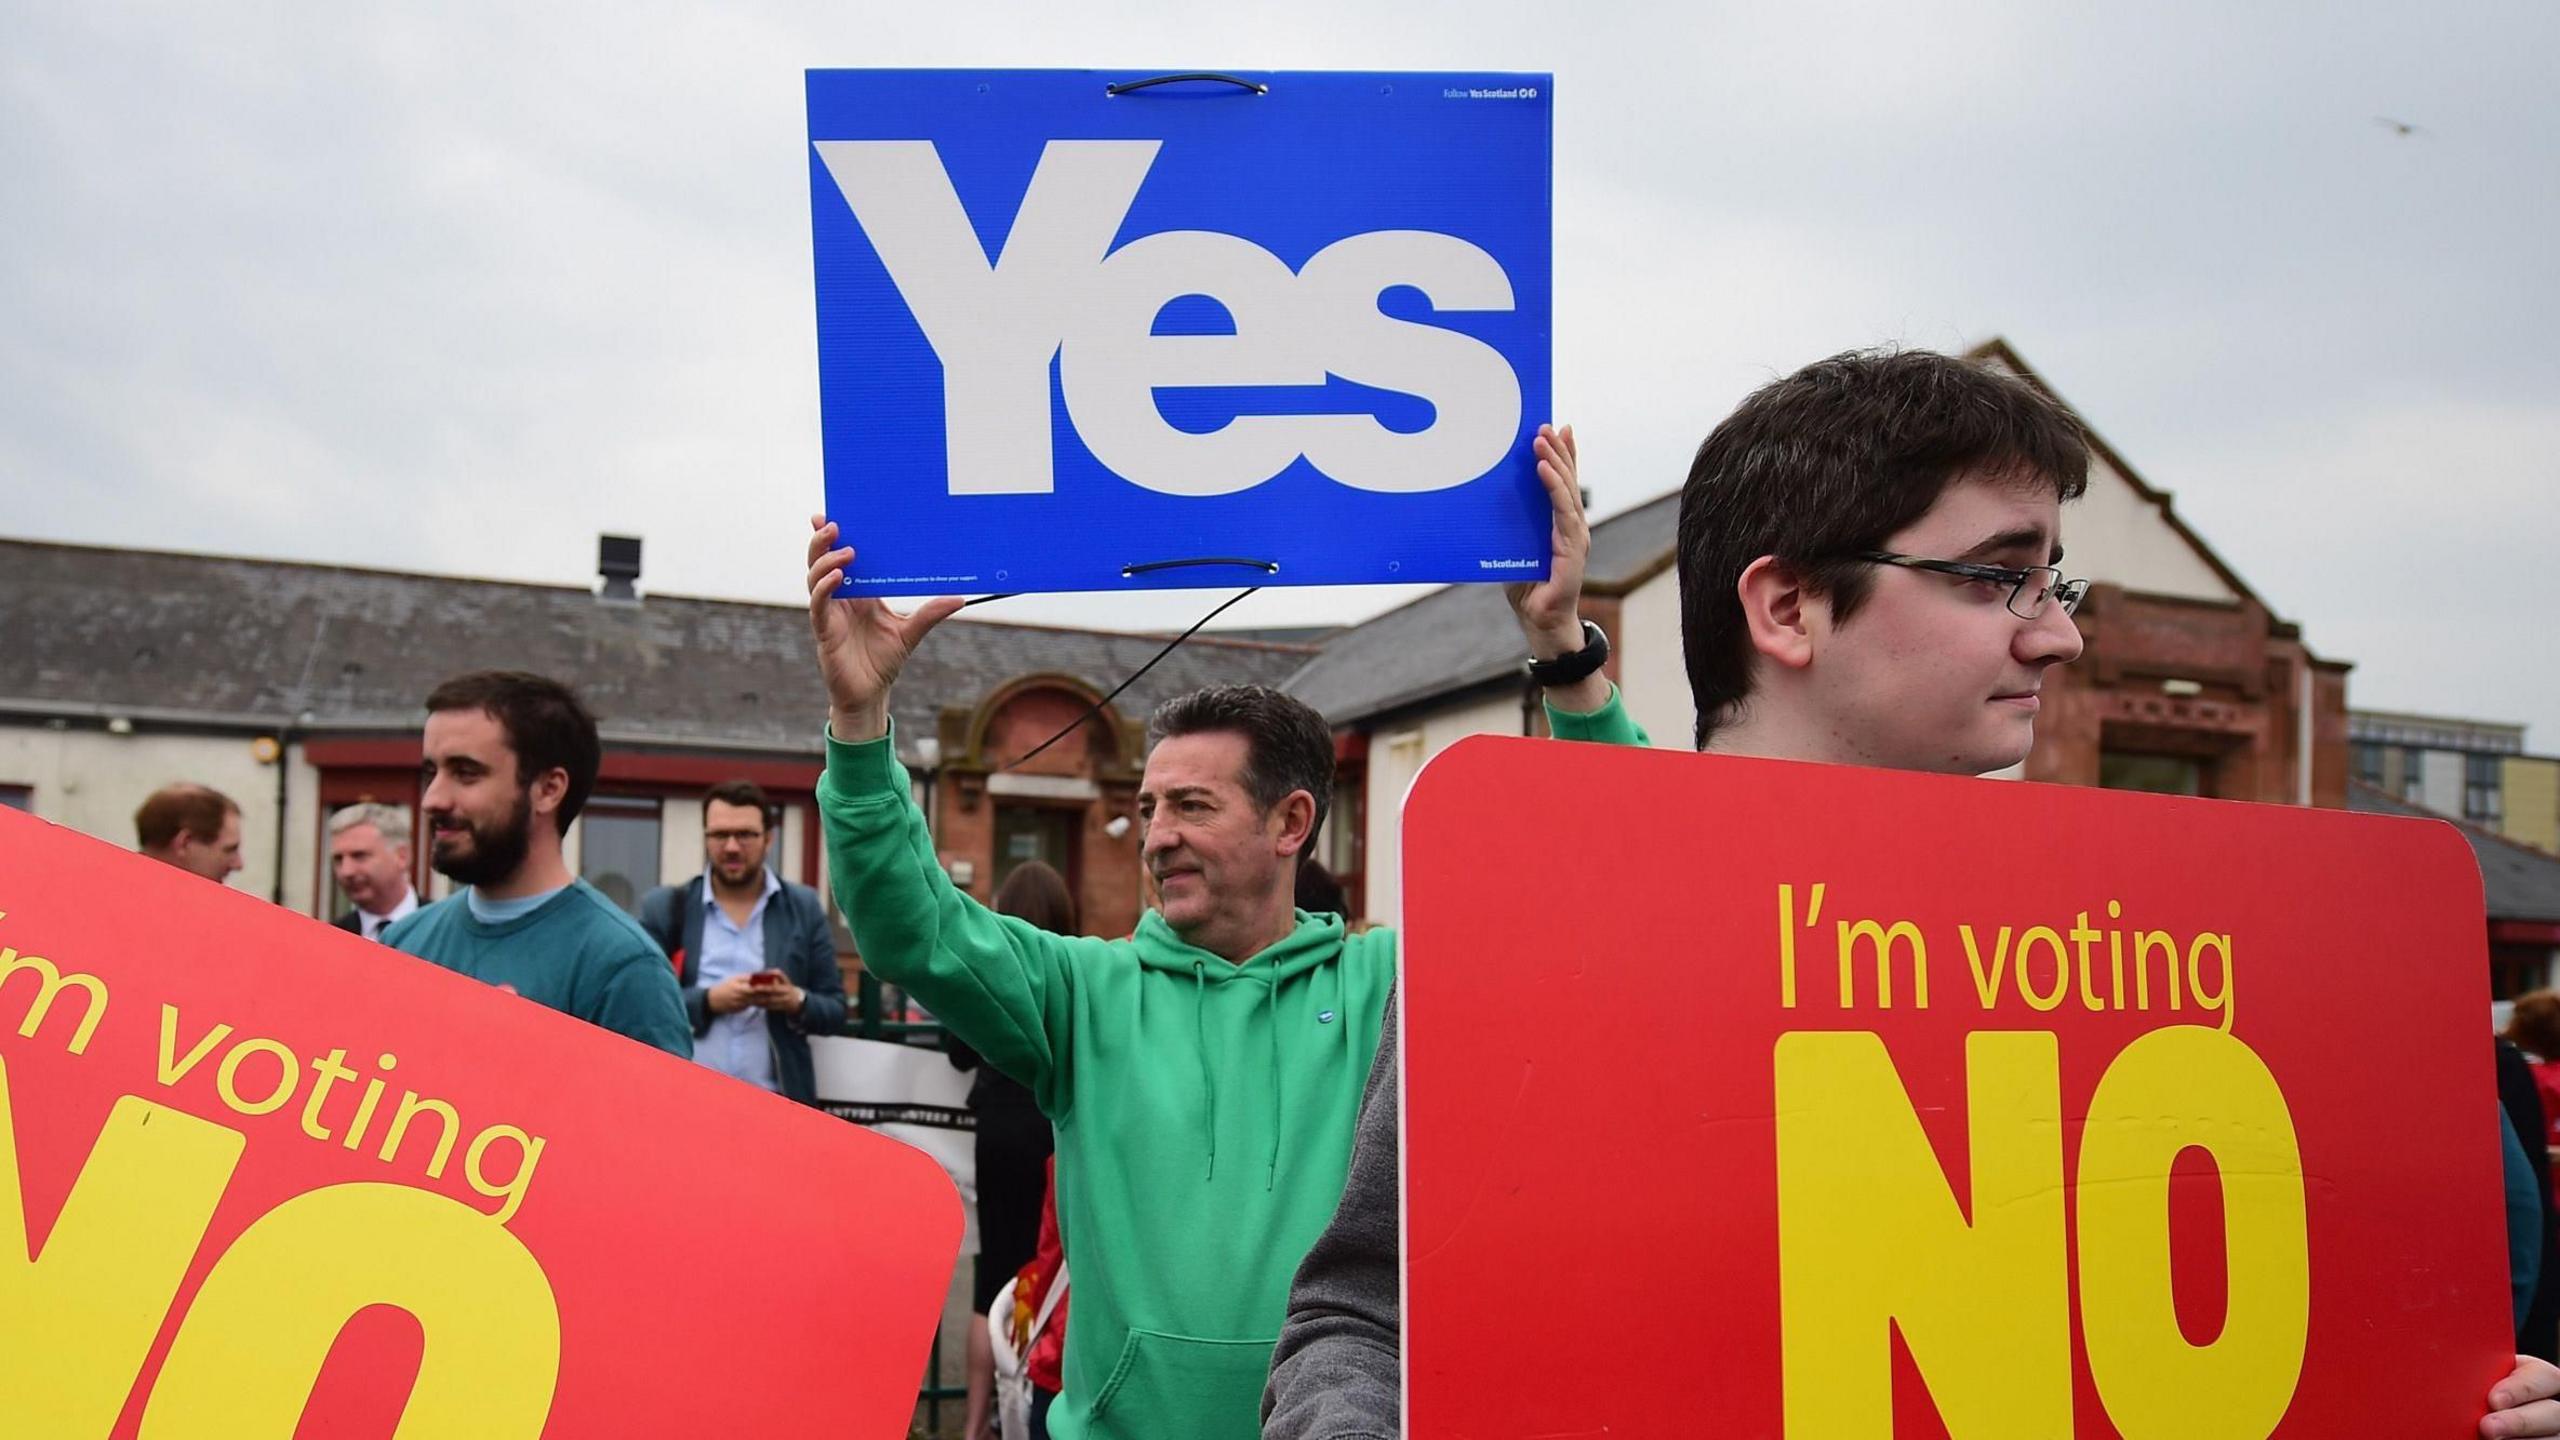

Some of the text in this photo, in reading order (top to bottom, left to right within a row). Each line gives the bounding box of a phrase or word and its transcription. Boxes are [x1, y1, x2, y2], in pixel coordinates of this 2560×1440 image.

[1443, 88, 1468, 99] Follow
[814, 139, 1521, 496] Yes
[0, 911, 547, 1226] m voting
[1778, 883, 2236, 1034] I'm voting
[1773, 1024, 2310, 1440] NO
